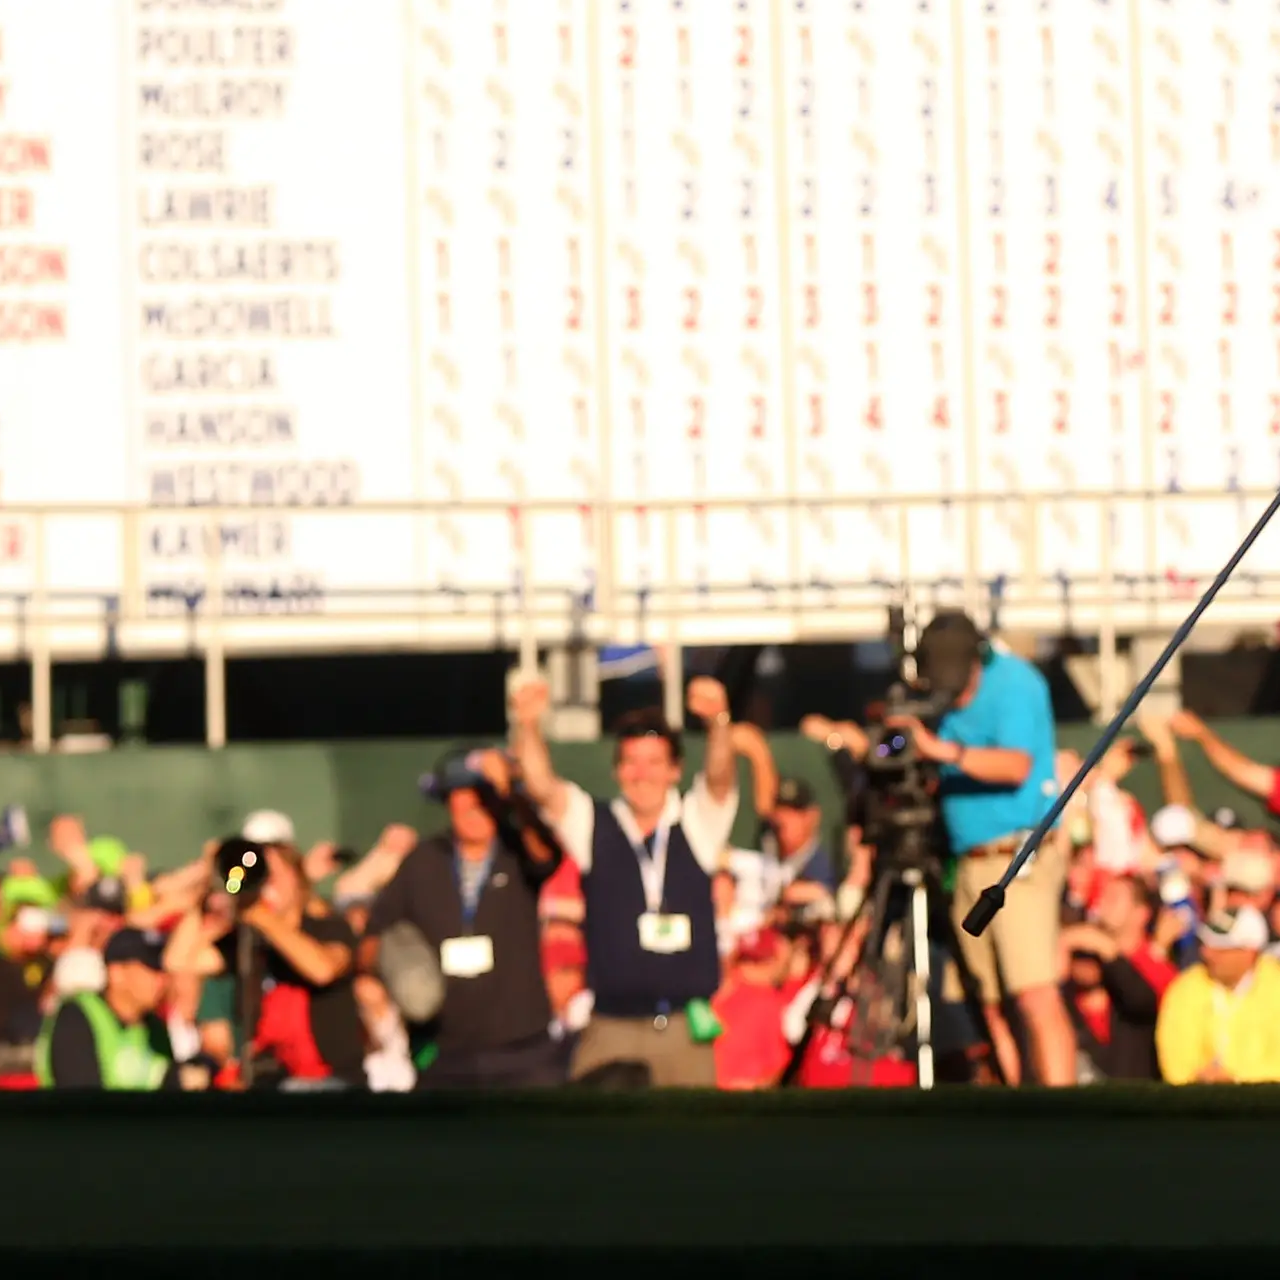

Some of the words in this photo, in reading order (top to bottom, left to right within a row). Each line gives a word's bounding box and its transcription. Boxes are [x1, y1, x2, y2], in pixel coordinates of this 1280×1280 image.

[136, 25, 289, 67] POULTER
[139, 133, 223, 169] ROSE
[135, 187, 268, 231] LAWRIE
[138, 241, 340, 284] COLSAERTS
[143, 350, 276, 395] GARCIA
[146, 412, 294, 444] HANSON
